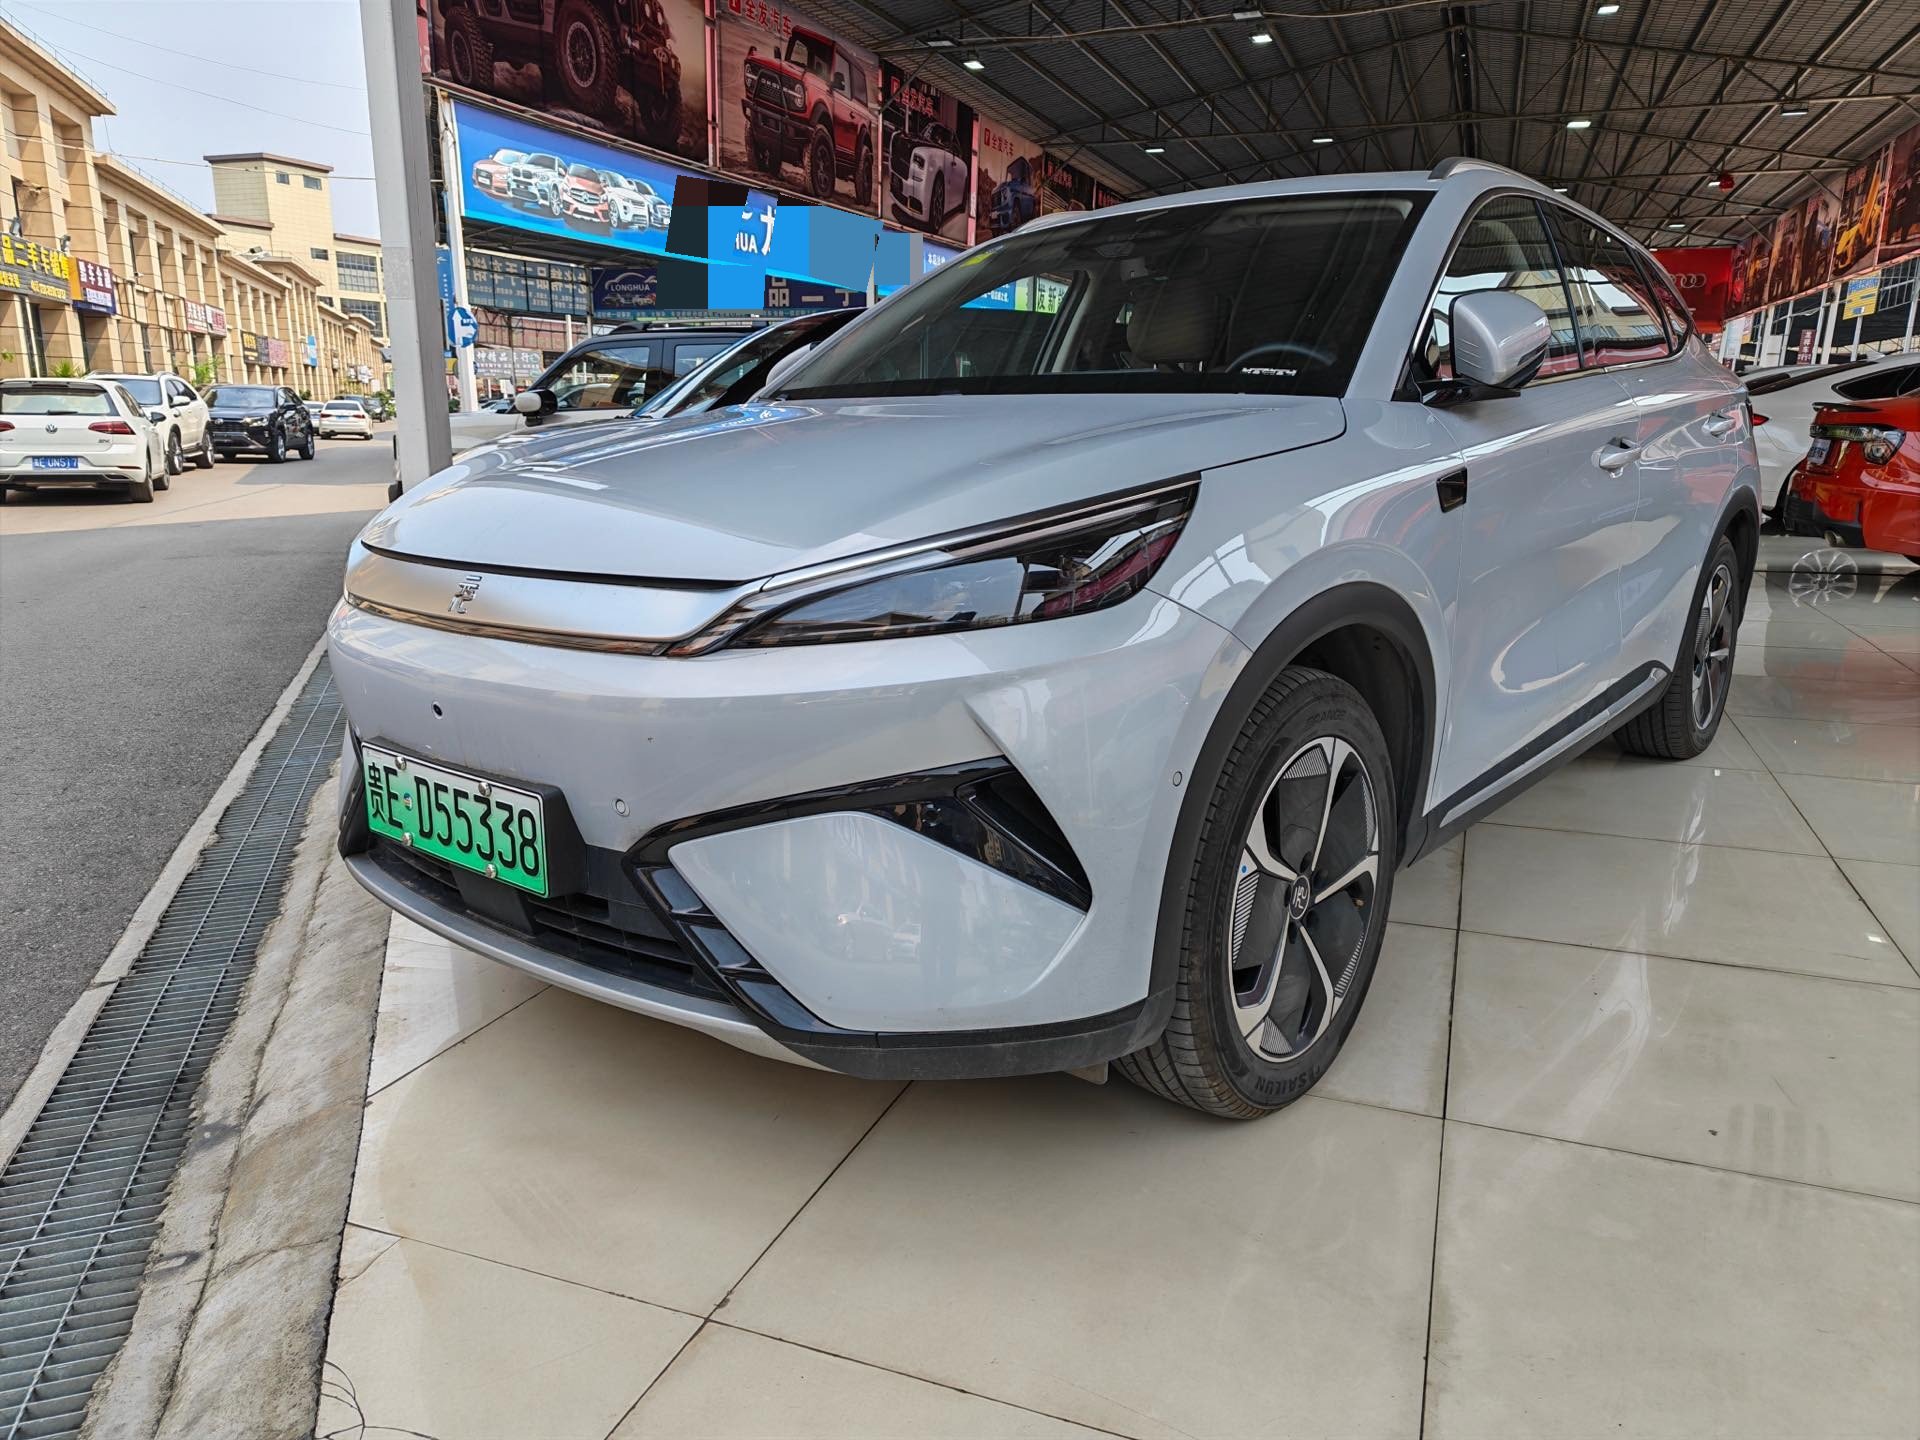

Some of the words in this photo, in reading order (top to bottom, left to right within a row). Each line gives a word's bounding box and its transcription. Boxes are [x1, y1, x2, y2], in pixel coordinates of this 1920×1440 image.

[744, 0, 792, 37] 全发汽车
[610, 283, 651, 292] LONGHUA
